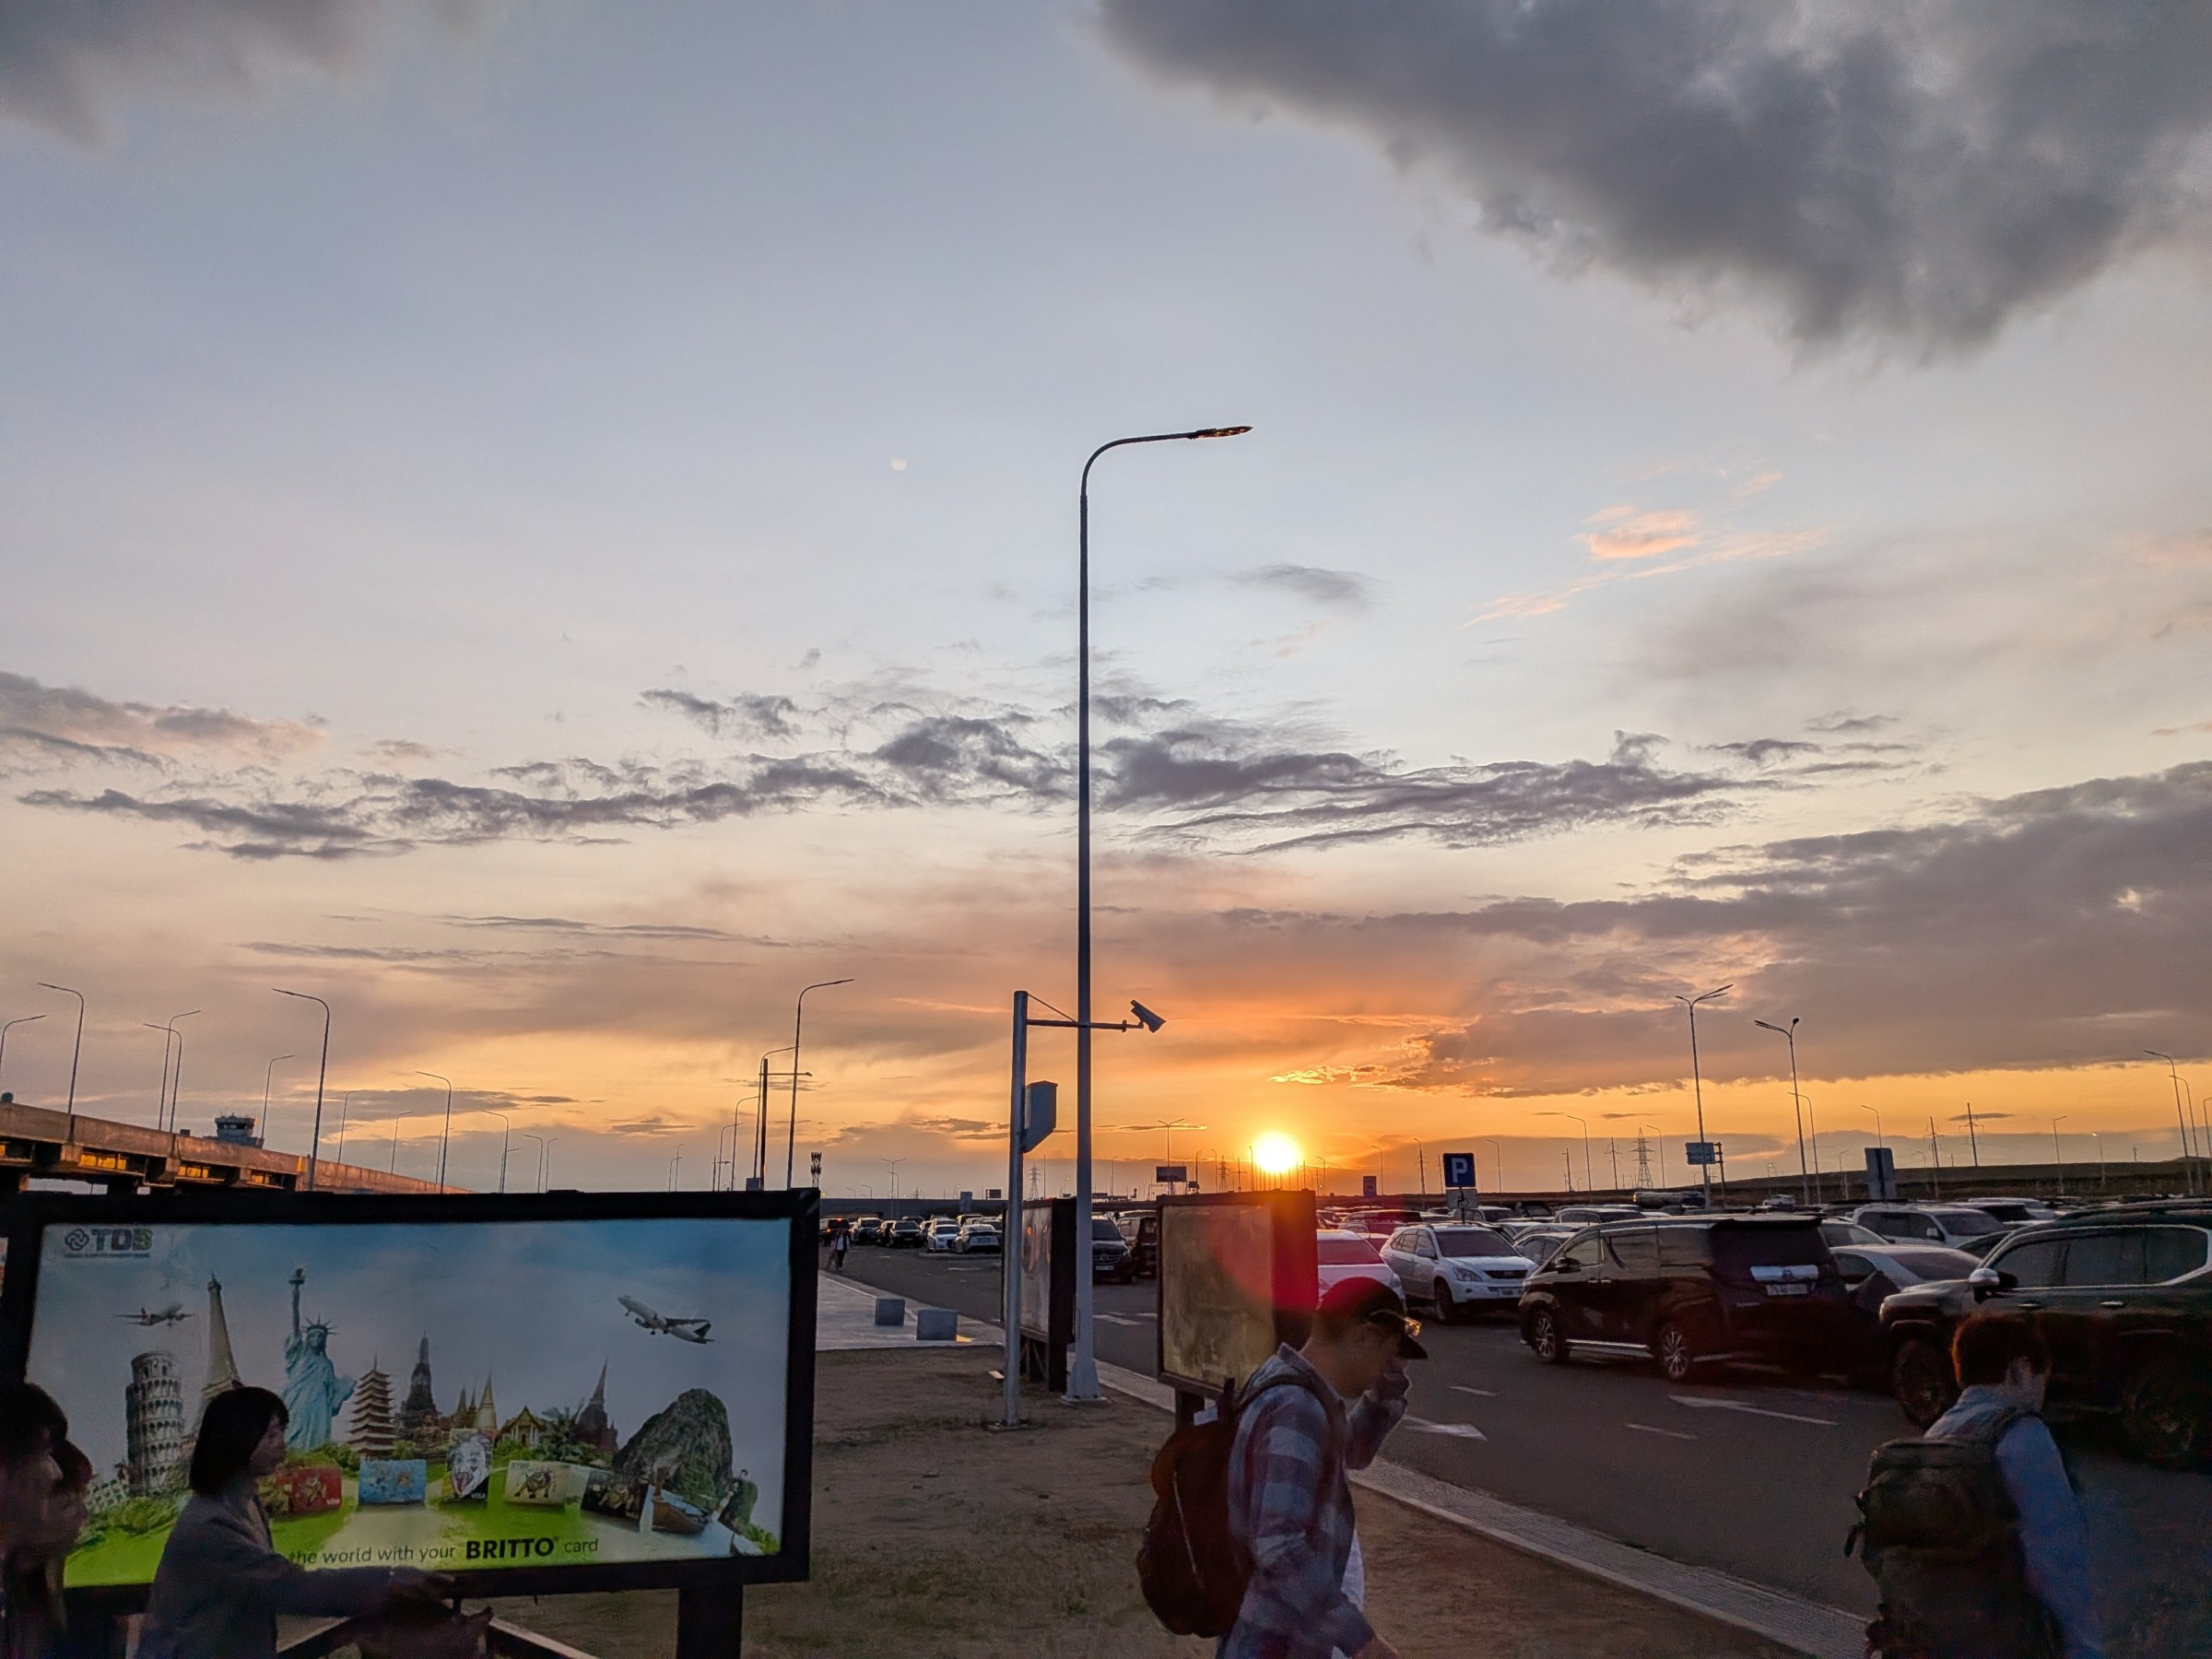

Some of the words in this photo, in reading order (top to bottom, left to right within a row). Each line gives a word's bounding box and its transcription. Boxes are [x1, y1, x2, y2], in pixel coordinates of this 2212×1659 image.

[1451, 1158, 1468, 1183] P
[90, 1229, 153, 1251] TDB
[323, 1547, 372, 1564] world
[378, 1545, 414, 1561] with
[419, 1546, 456, 1562] your
[465, 1536, 555, 1560] BRITTO
[564, 1538, 599, 1553] card
